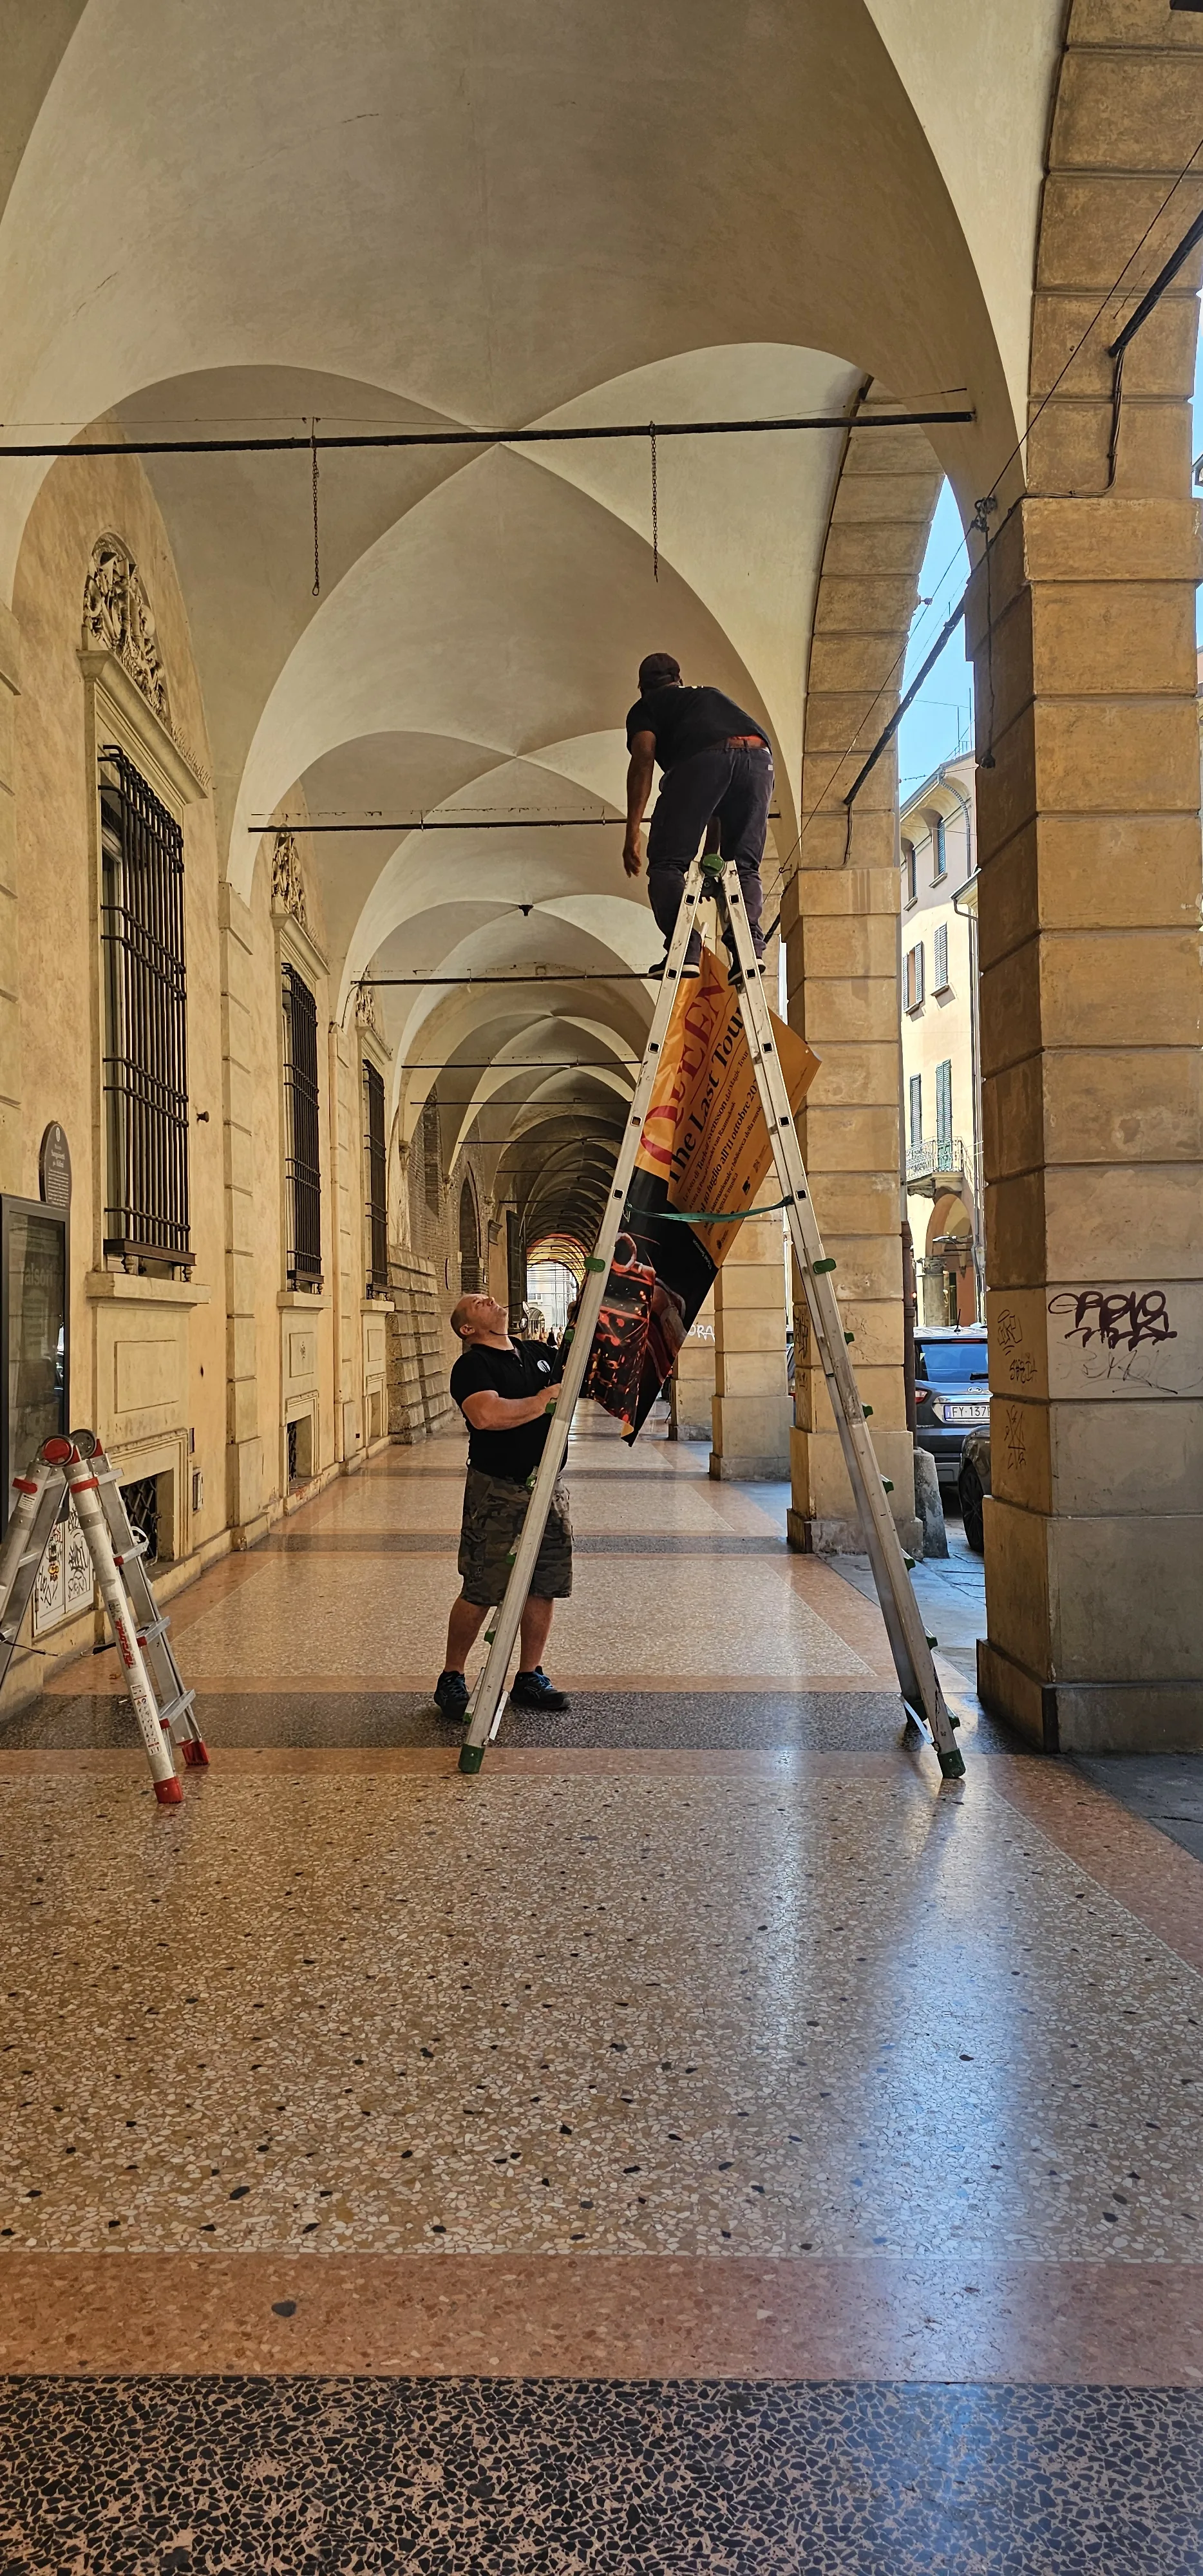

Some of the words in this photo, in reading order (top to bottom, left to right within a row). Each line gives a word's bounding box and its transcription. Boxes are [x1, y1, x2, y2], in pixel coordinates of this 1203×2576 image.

[640, 971, 725, 1166] QUEEN
[687, 1179, 696, 1195] foto
[706, 1101, 727, 1141] Svensson
[728, 1069, 740, 1090] Magic
[737, 1051, 749, 1068] Tour
[688, 1070, 719, 1132] Last
[706, 1164, 723, 1193] luglio
[730, 1101, 750, 1139] ottobre
[731, 1138, 747, 1167] biblioteca
[744, 1122, 754, 1138] della
[690, 1193, 699, 1206] cura
[969, 1406, 990, 1417] 137
